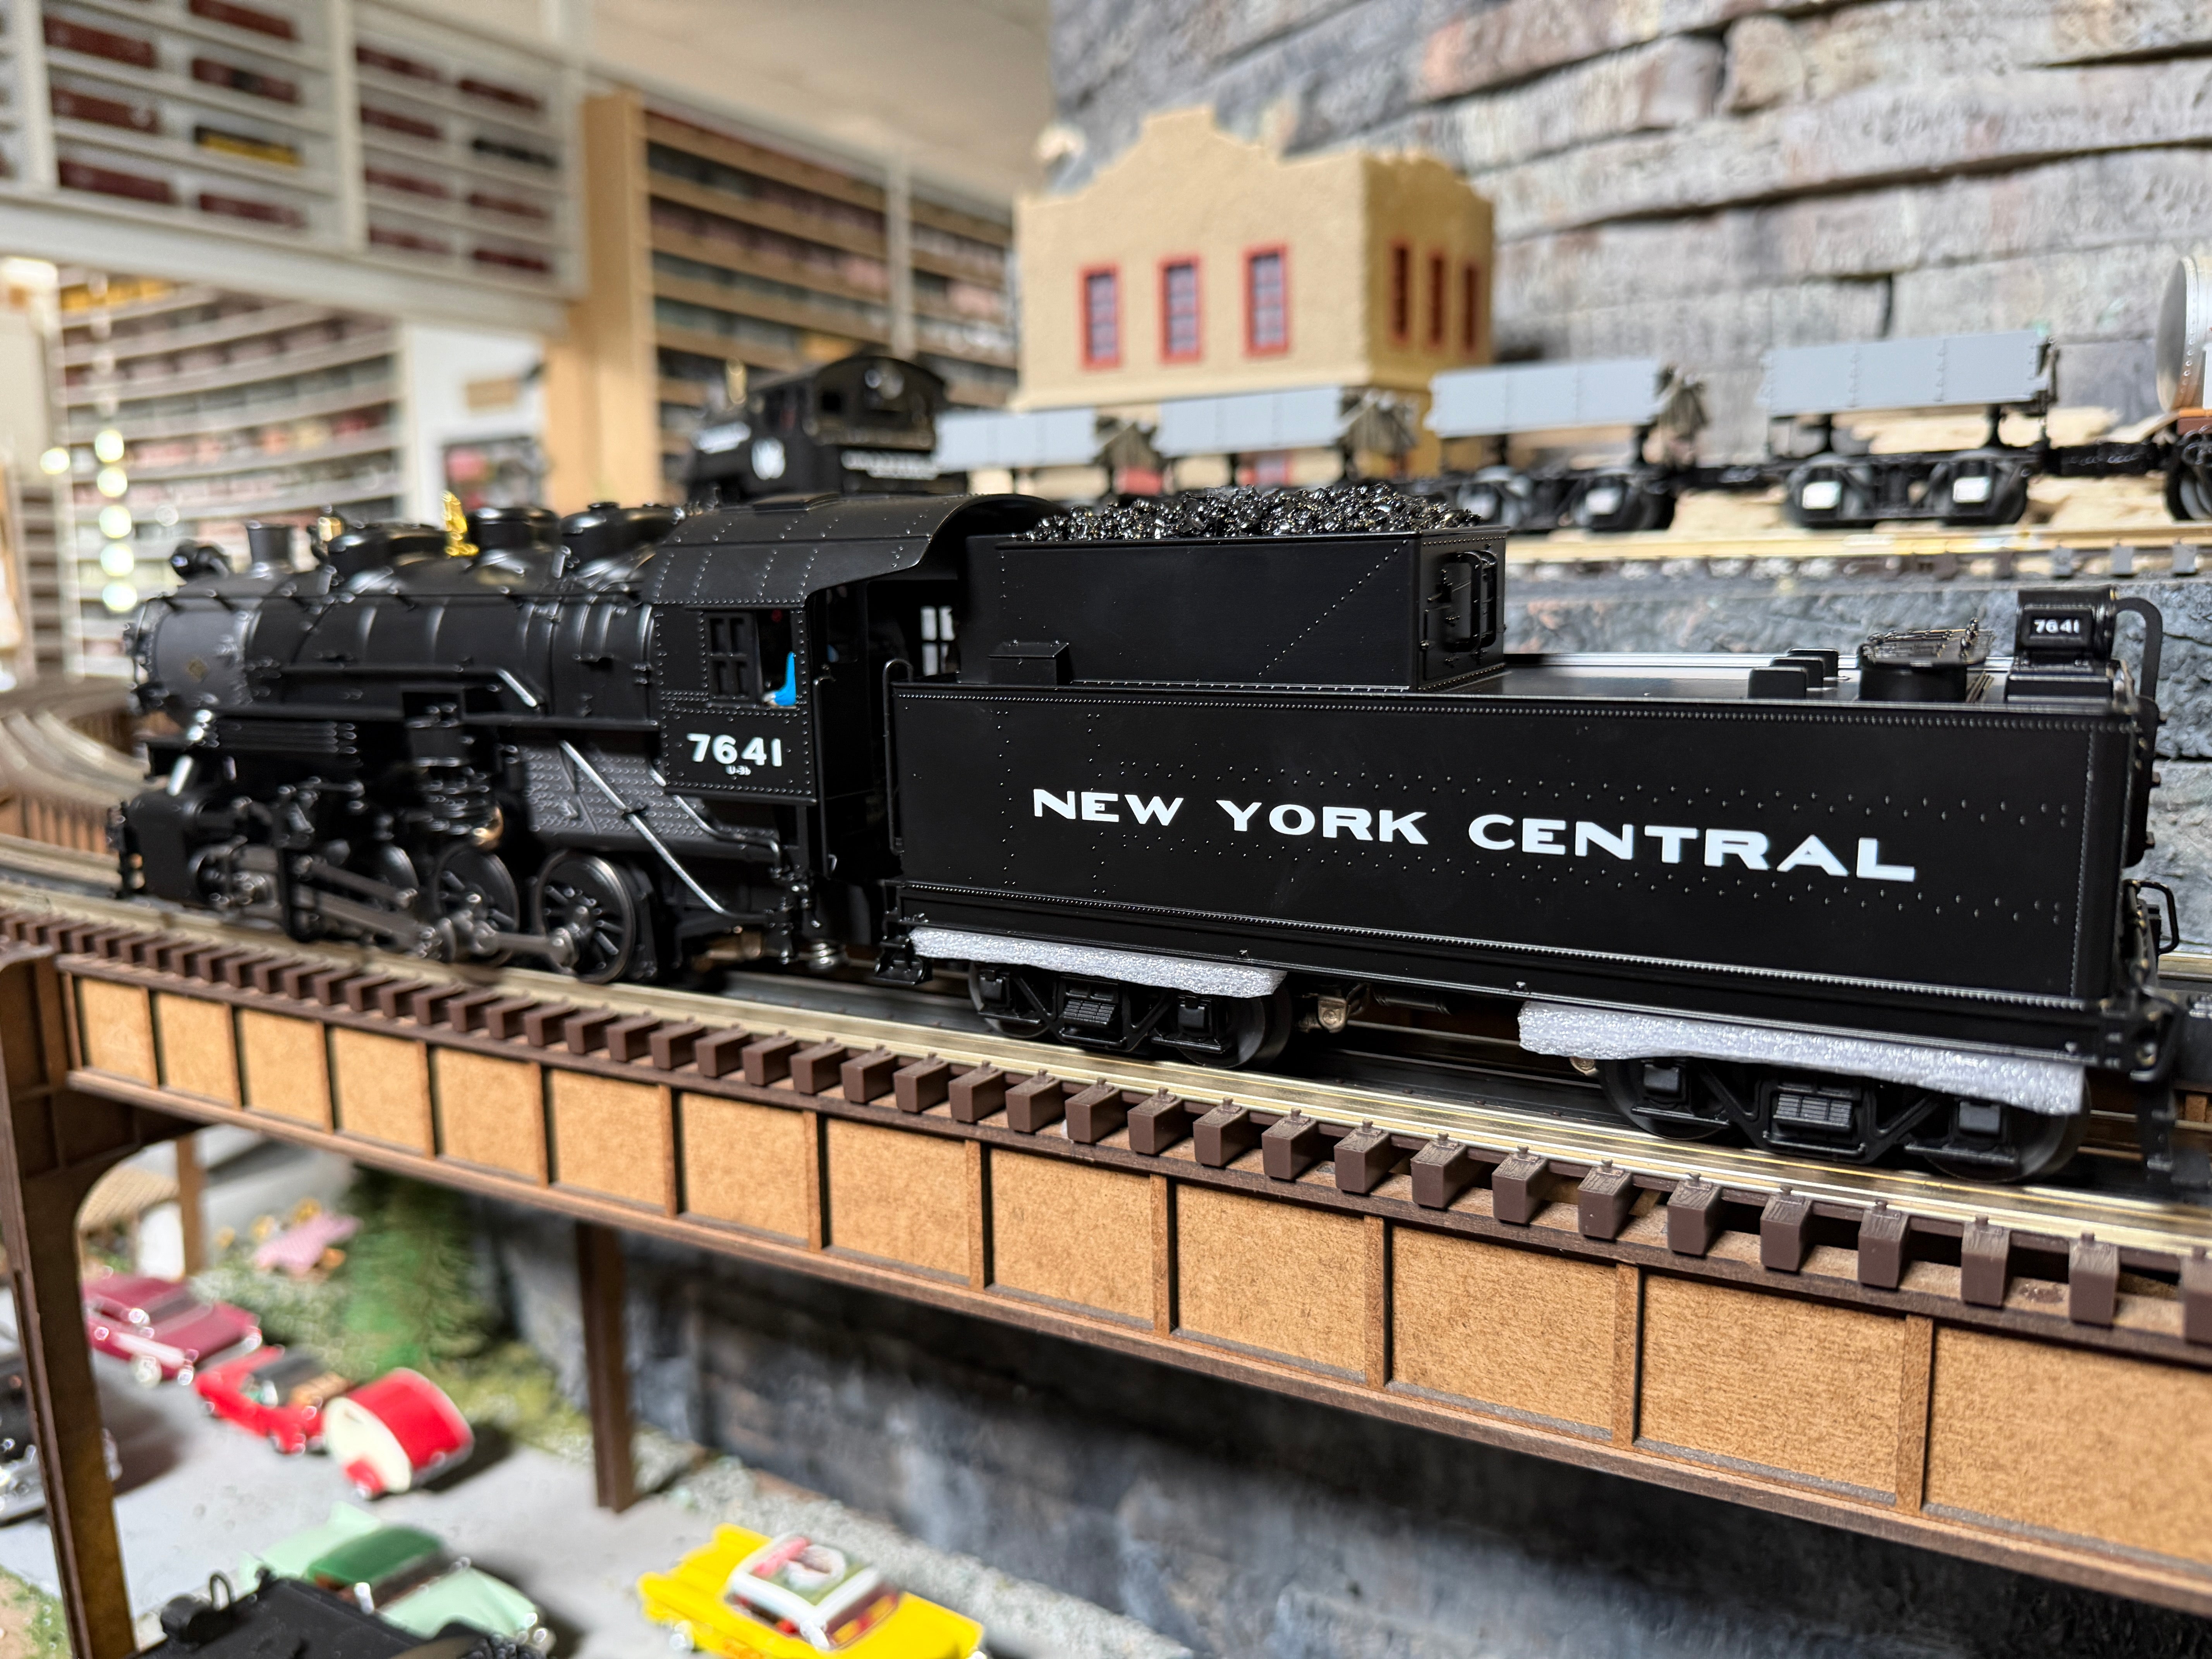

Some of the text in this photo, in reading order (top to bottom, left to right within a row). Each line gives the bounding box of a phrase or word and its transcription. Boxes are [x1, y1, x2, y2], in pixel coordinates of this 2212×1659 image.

[2033, 619, 2080, 634] 7641
[687, 733, 783, 767] 7641
[1033, 788, 1916, 882] NEW YORK CENTRAL
